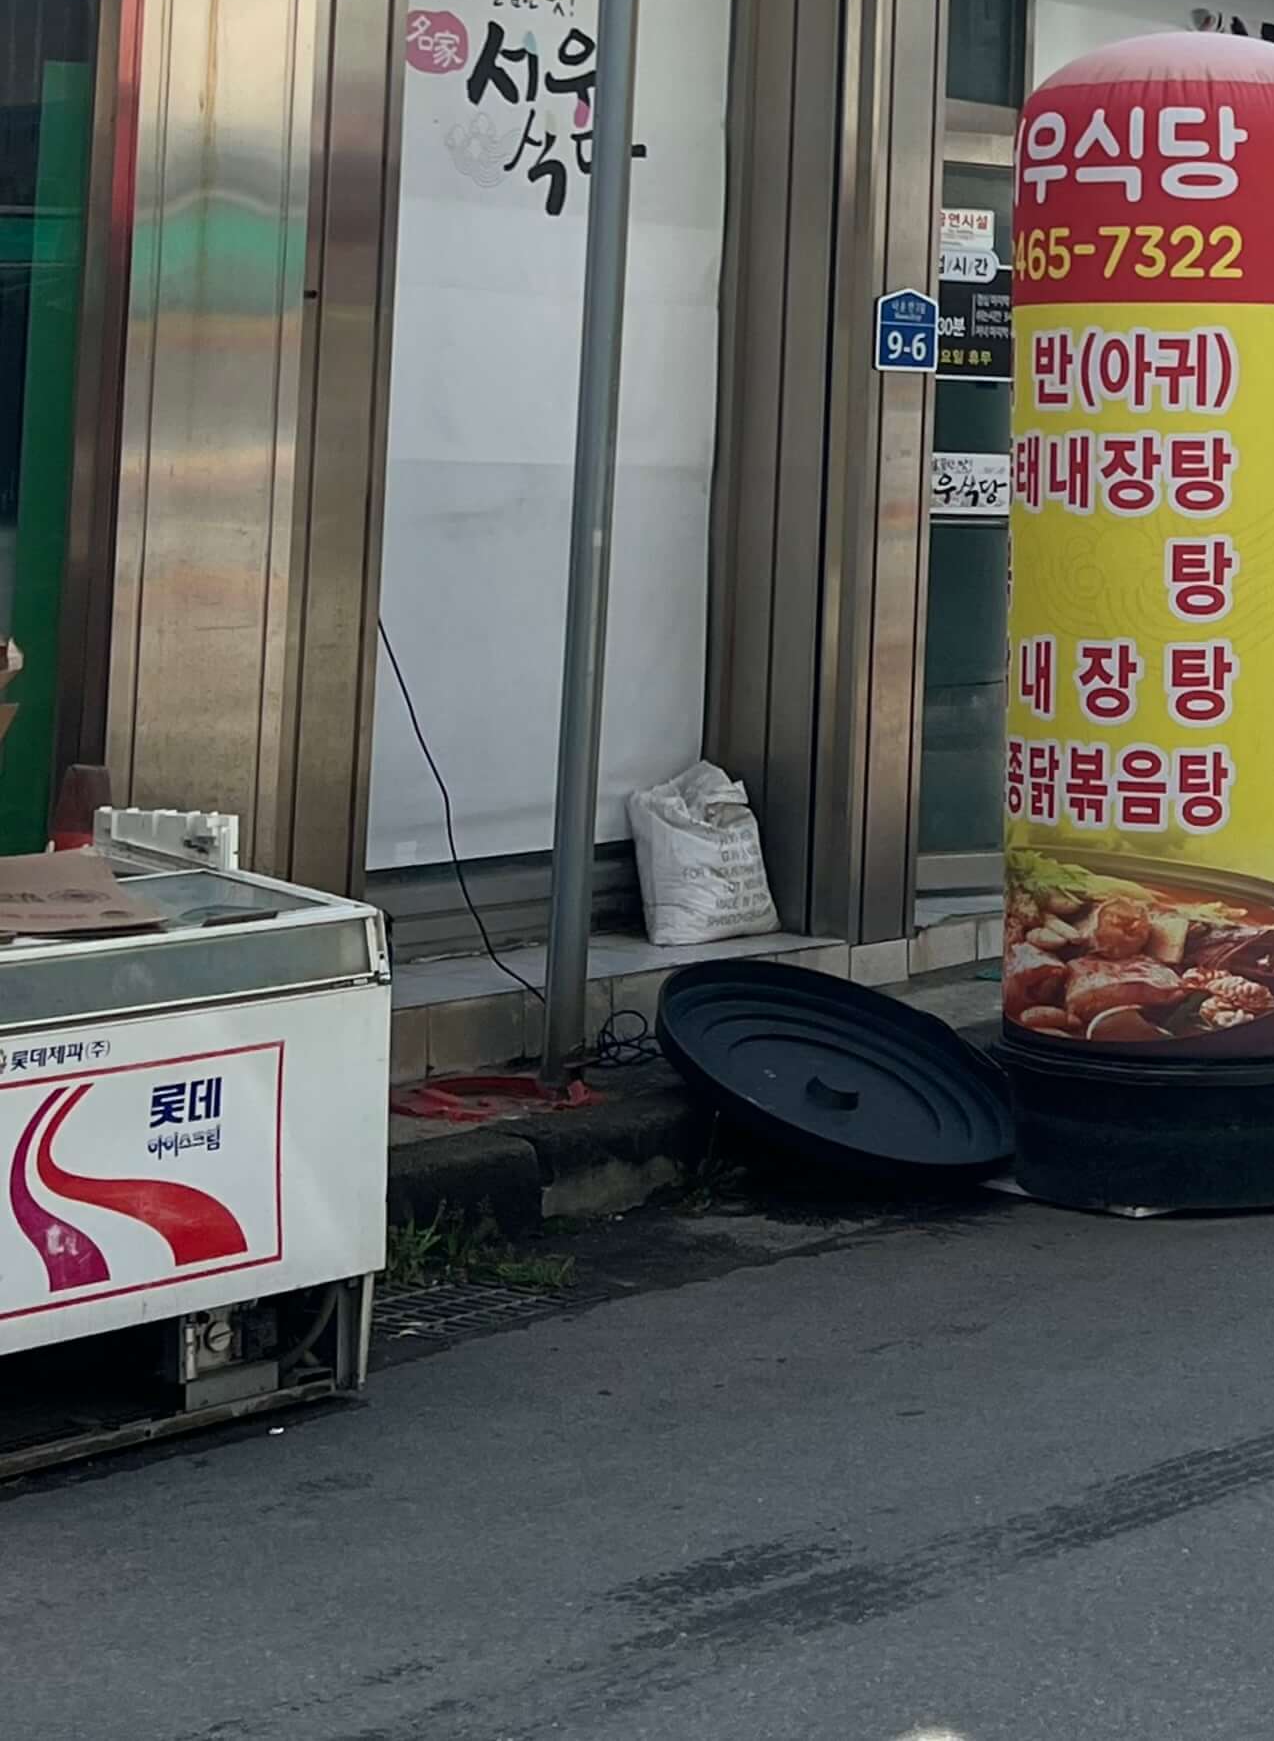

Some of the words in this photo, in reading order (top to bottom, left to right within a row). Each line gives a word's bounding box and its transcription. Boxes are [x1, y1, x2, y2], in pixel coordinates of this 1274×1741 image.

[406, 15, 464, 68] 名家
[466, 20, 597, 129] 서우
[1013, 106, 1249, 203] 우식당
[887, 330, 927, 361] 9-6
[1171, 540, 1233, 616] 탕
[10, 1040, 111, 1071] 롯데제과(주)
[149, 1077, 222, 1128] 롯데
[147, 1125, 221, 1160] 아이스크림
